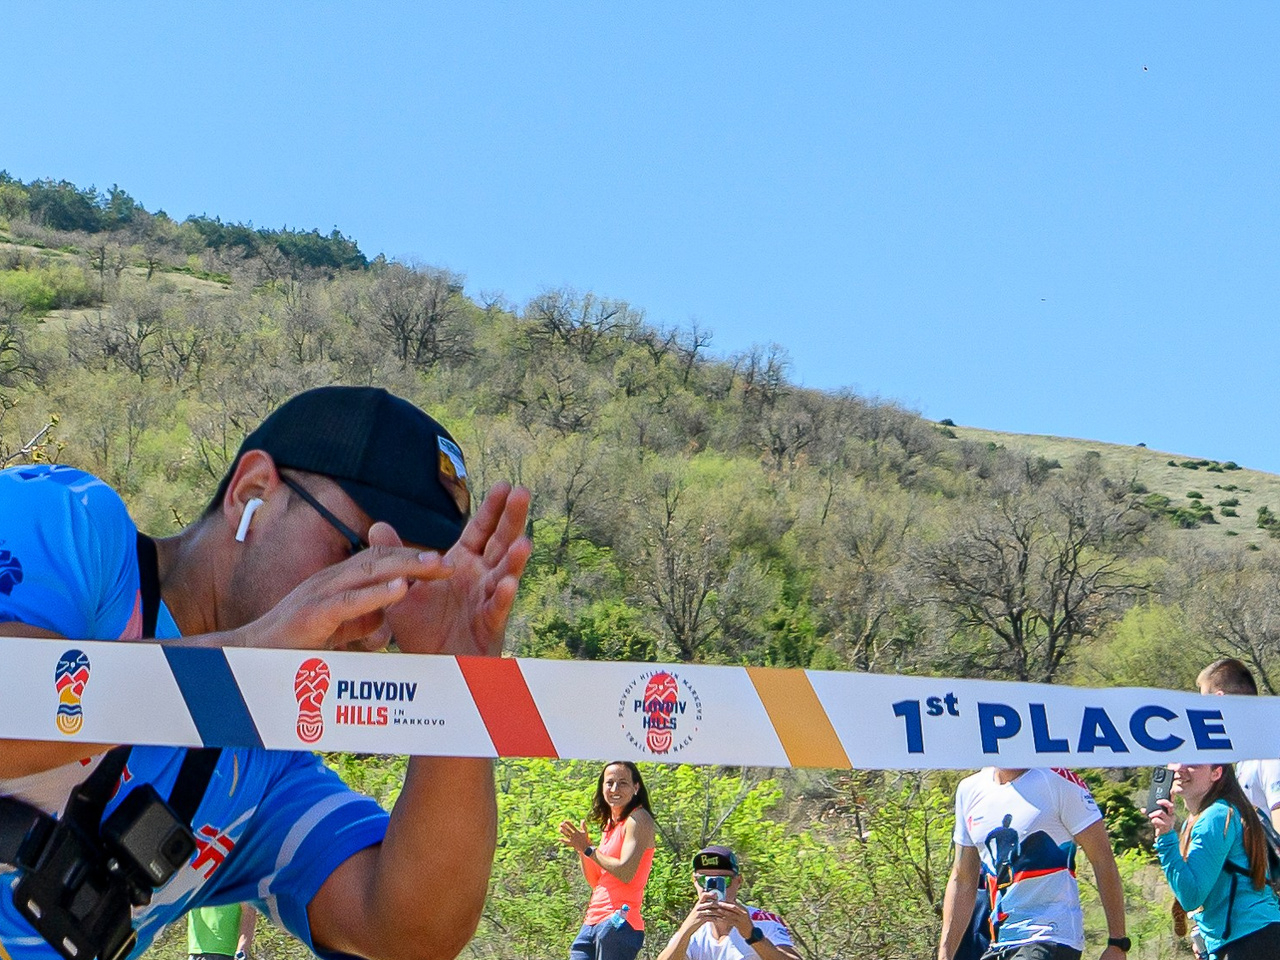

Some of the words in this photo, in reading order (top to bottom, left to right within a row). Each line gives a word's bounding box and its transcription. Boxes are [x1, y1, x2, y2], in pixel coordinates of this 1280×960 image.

[336, 680, 418, 702] PLOVDIV
[335, 705, 388, 726] HILLS
[634, 700, 687, 715] PLOVDIV
[393, 718, 446, 726] MARKOVO
[642, 716, 677, 730] HILLS
[891, 691, 960, 754] 1st
[977, 701, 1234, 754] PLACE
